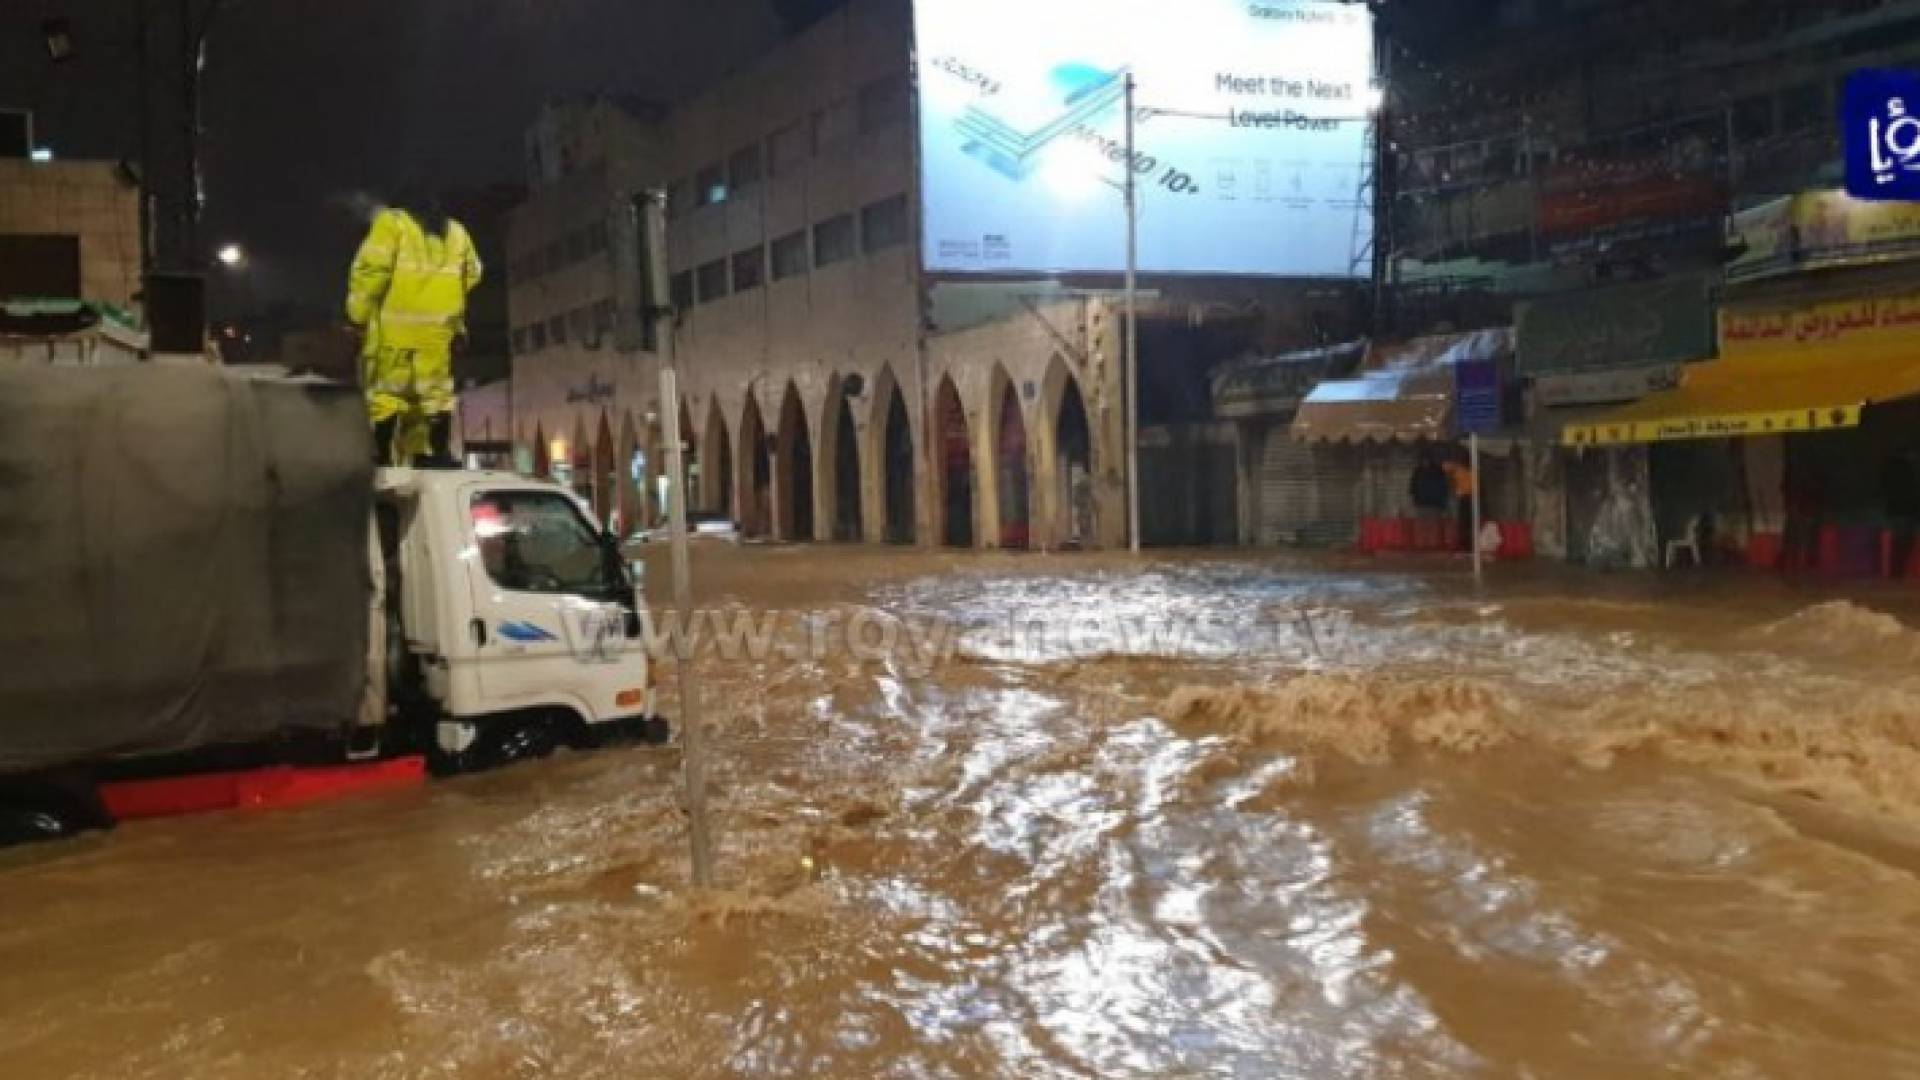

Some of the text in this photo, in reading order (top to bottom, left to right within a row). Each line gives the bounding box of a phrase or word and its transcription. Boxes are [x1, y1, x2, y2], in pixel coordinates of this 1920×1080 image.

[1215, 72, 1353, 99] Meet the Next
[1229, 105, 1340, 131] Level Power
